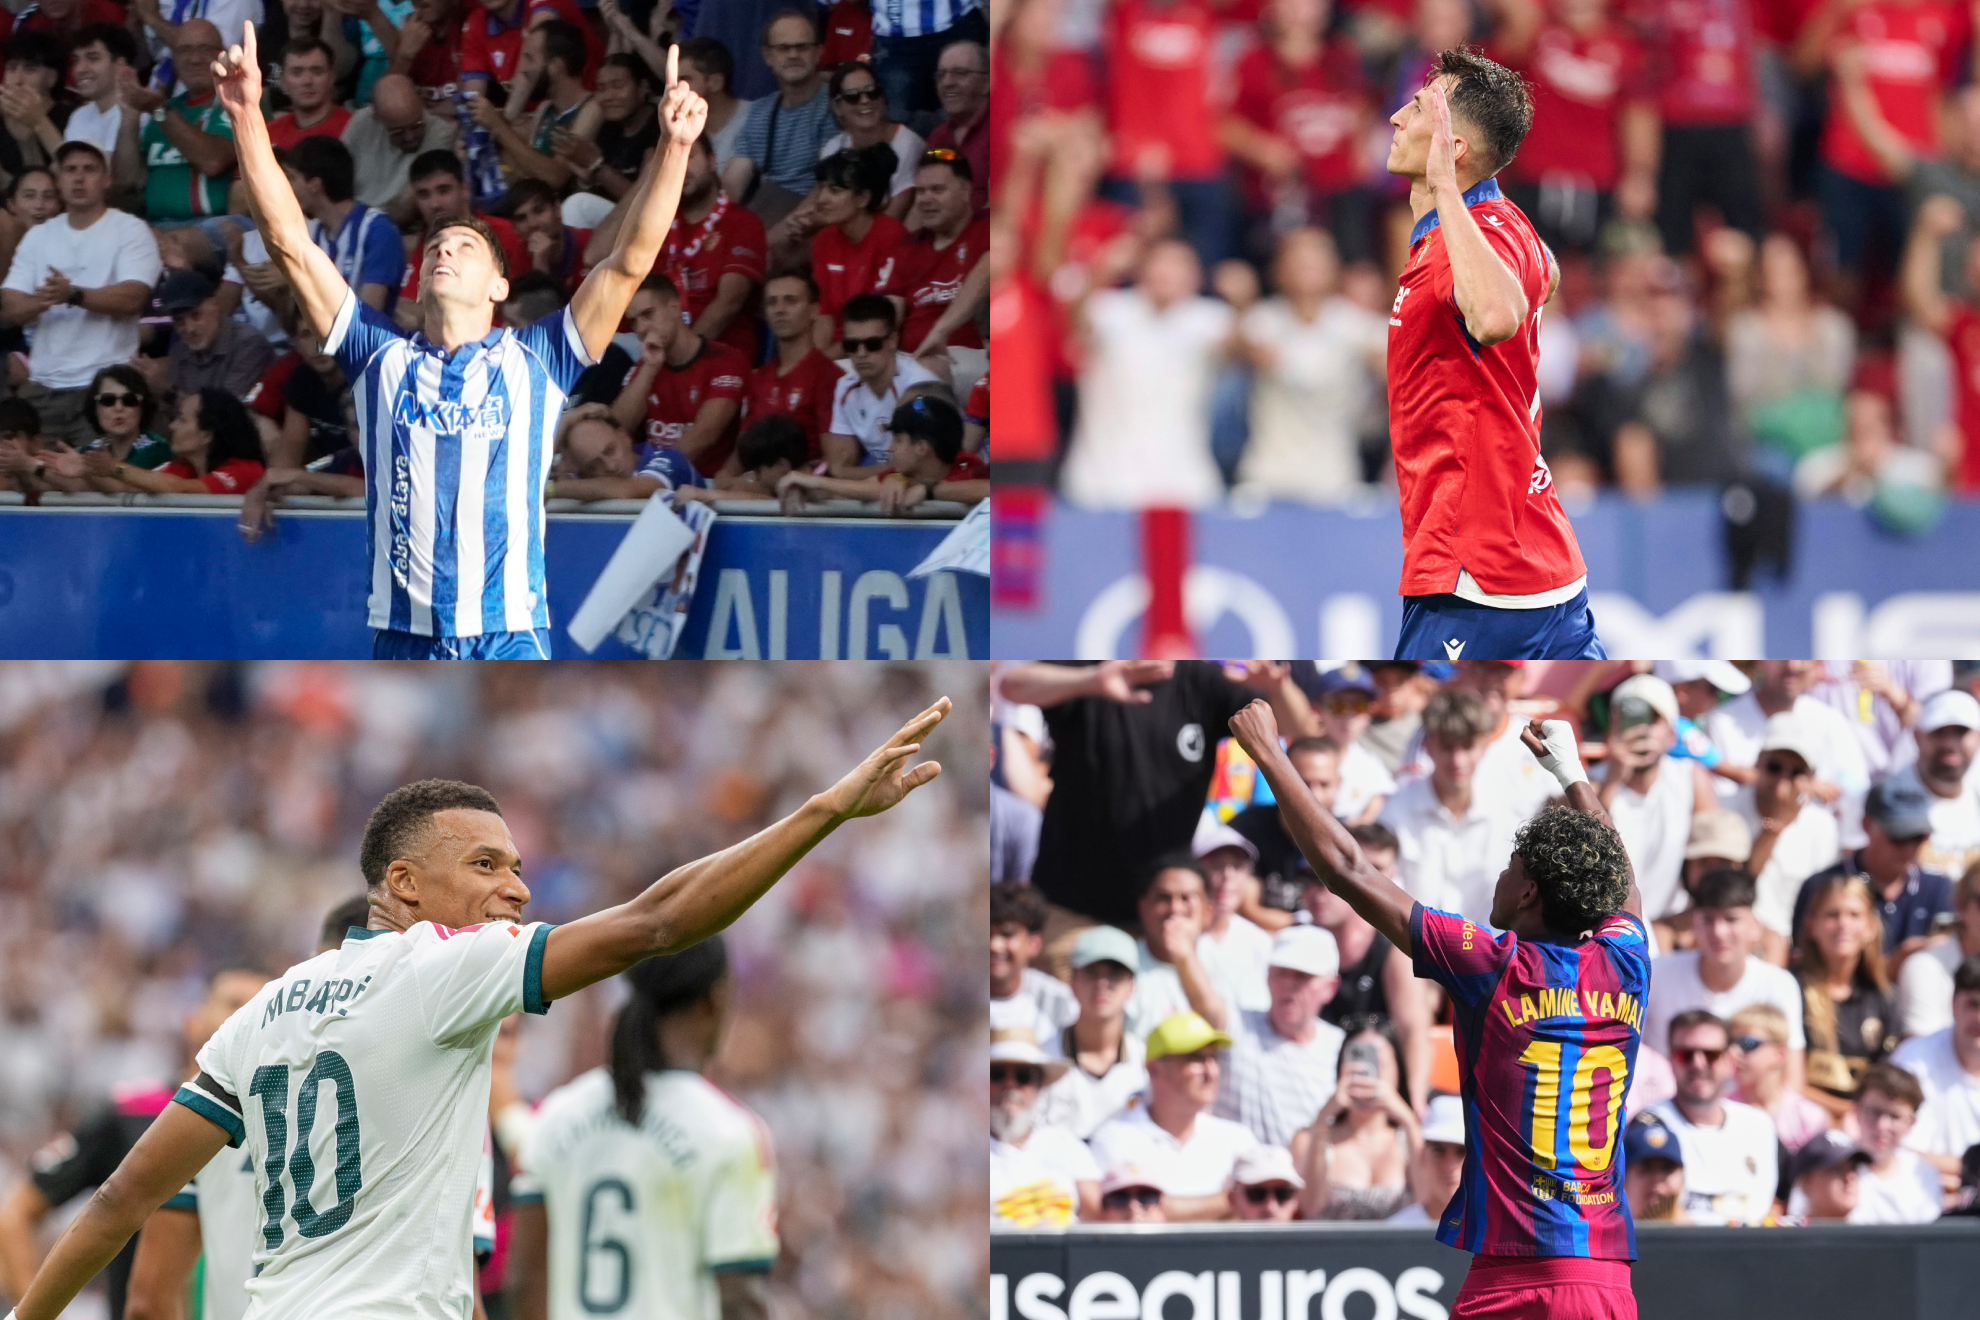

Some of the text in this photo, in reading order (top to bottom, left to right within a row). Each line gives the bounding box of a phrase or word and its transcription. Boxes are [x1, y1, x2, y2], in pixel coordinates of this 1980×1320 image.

[1501, 987, 1644, 1036] LAMINE YAMAL
[248, 1050, 363, 1251] 10
[1517, 1040, 1629, 1171] 10
[578, 1176, 635, 1317] 6
[1561, 1191, 1614, 1206] FOUNDATION
